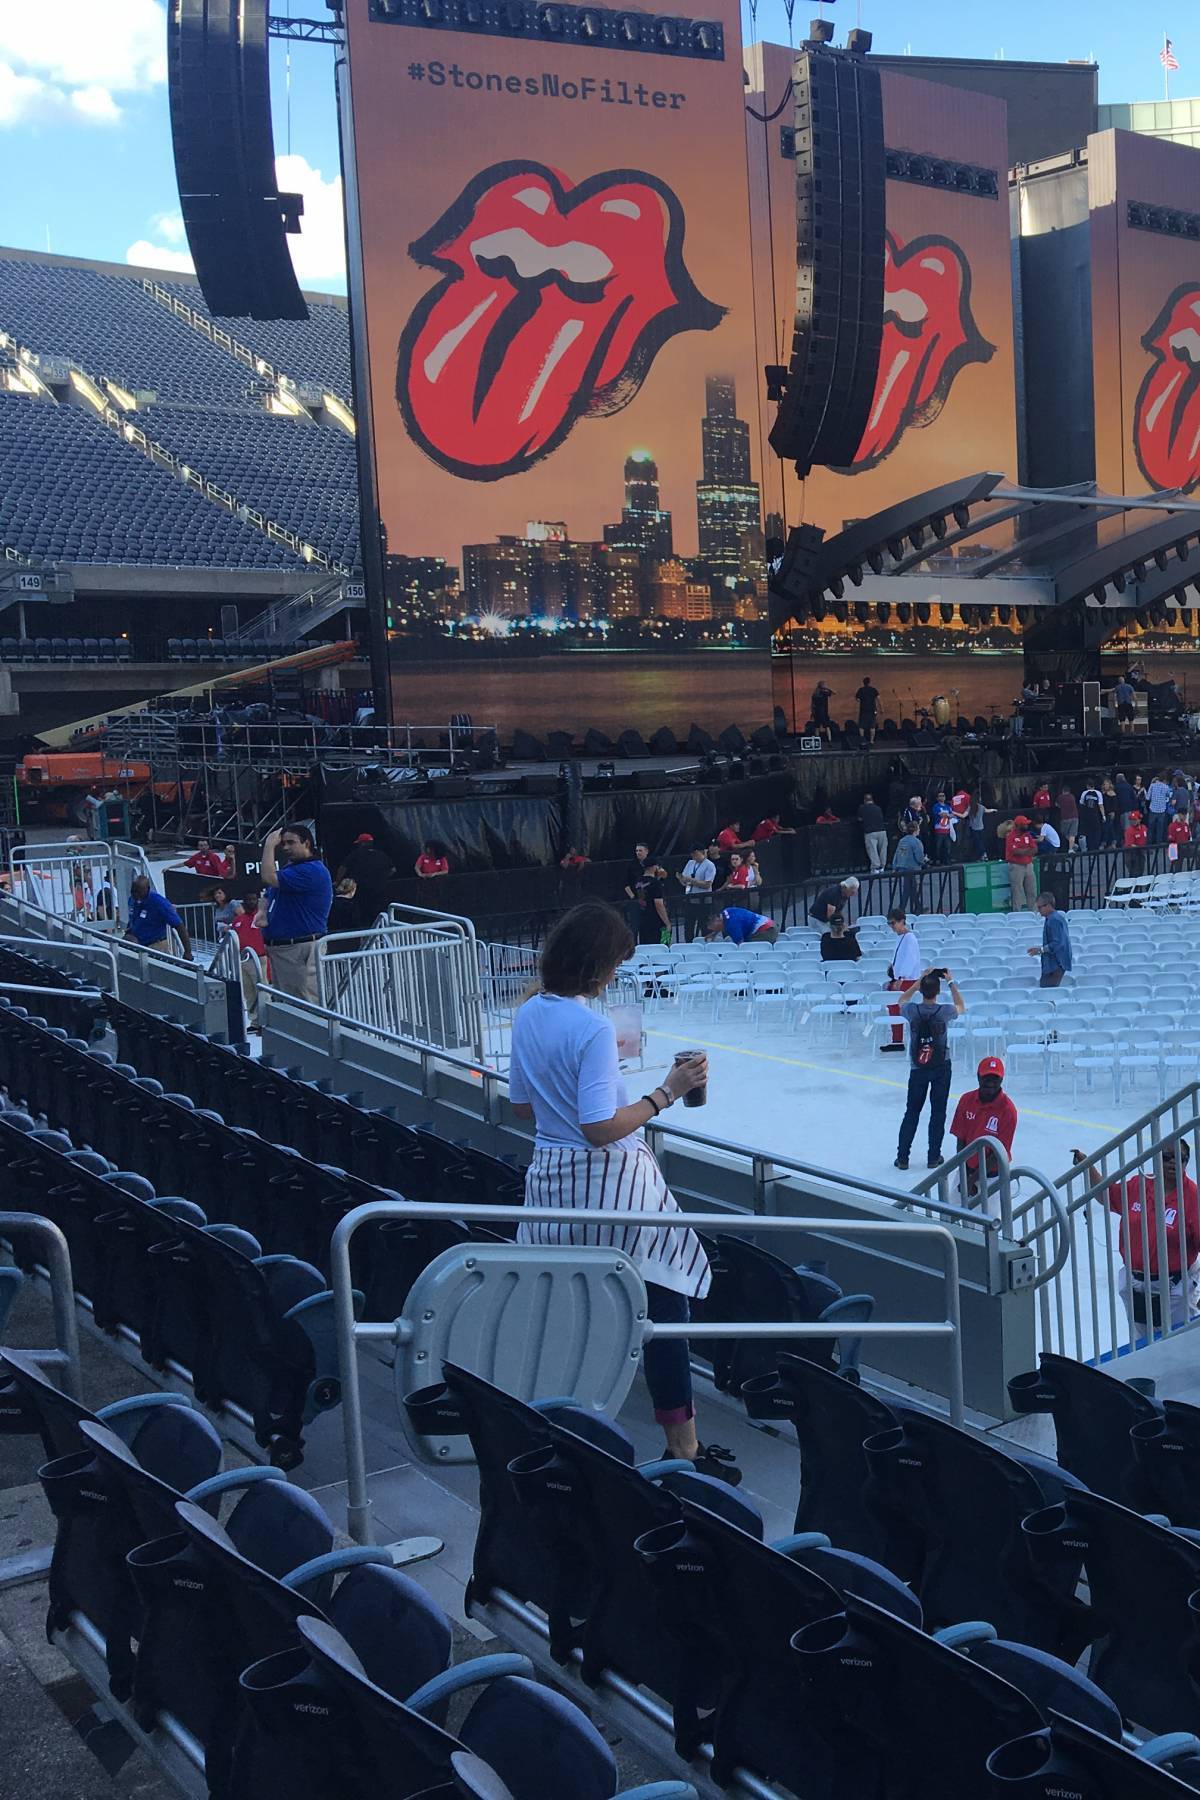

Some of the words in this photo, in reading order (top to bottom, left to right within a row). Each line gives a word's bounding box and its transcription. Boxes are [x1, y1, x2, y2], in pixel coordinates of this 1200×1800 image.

[407, 61, 688, 110] #StonesNoFilter
[21, 577, 40, 588] 149
[348, 585, 363, 597] 150
[80, 1489, 108, 1502] verizon
[1062, 1539, 1089, 1550] verizon
[675, 1562, 705, 1573] verizon
[173, 1577, 204, 1591] verizon
[840, 1656, 873, 1668] verizon
[294, 1702, 330, 1716] verizon
[1045, 1787, 1083, 1800] verizon
